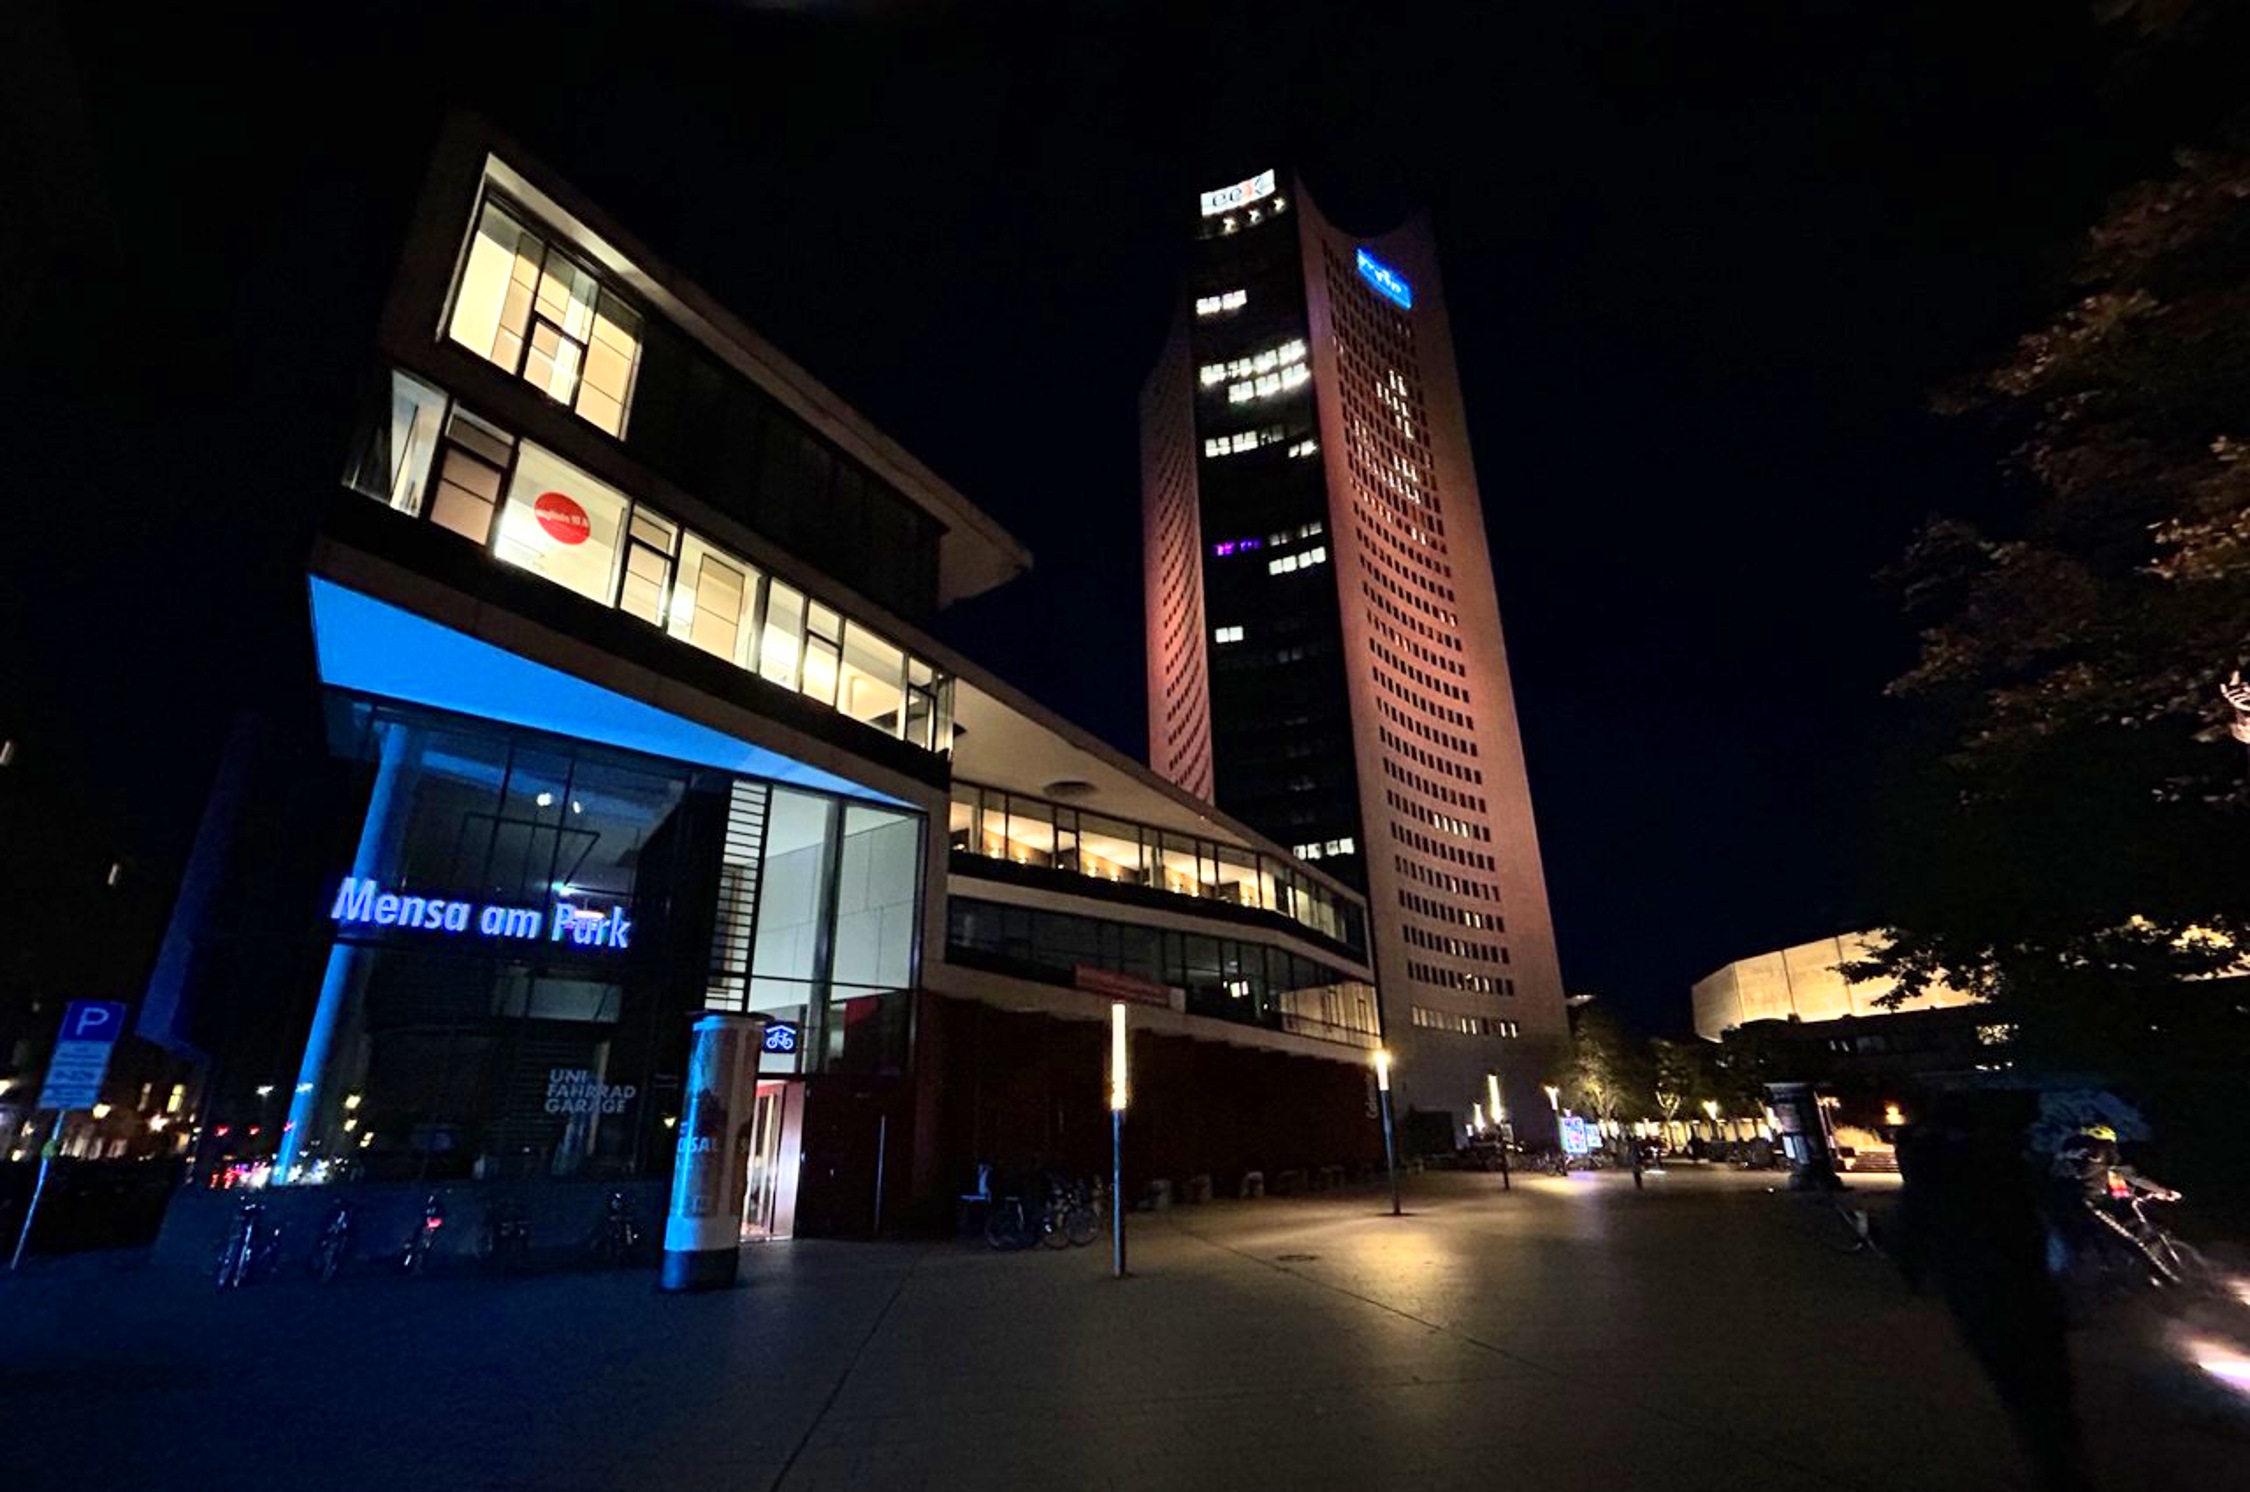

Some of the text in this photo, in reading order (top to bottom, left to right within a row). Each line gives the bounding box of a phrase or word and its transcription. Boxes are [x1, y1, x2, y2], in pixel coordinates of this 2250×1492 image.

[331, 877, 631, 948] Mensa am Park
[76, 1007, 110, 1036] P
[547, 1084, 637, 1099] FAHRRAD
[545, 1098, 627, 1114] GARAGE
